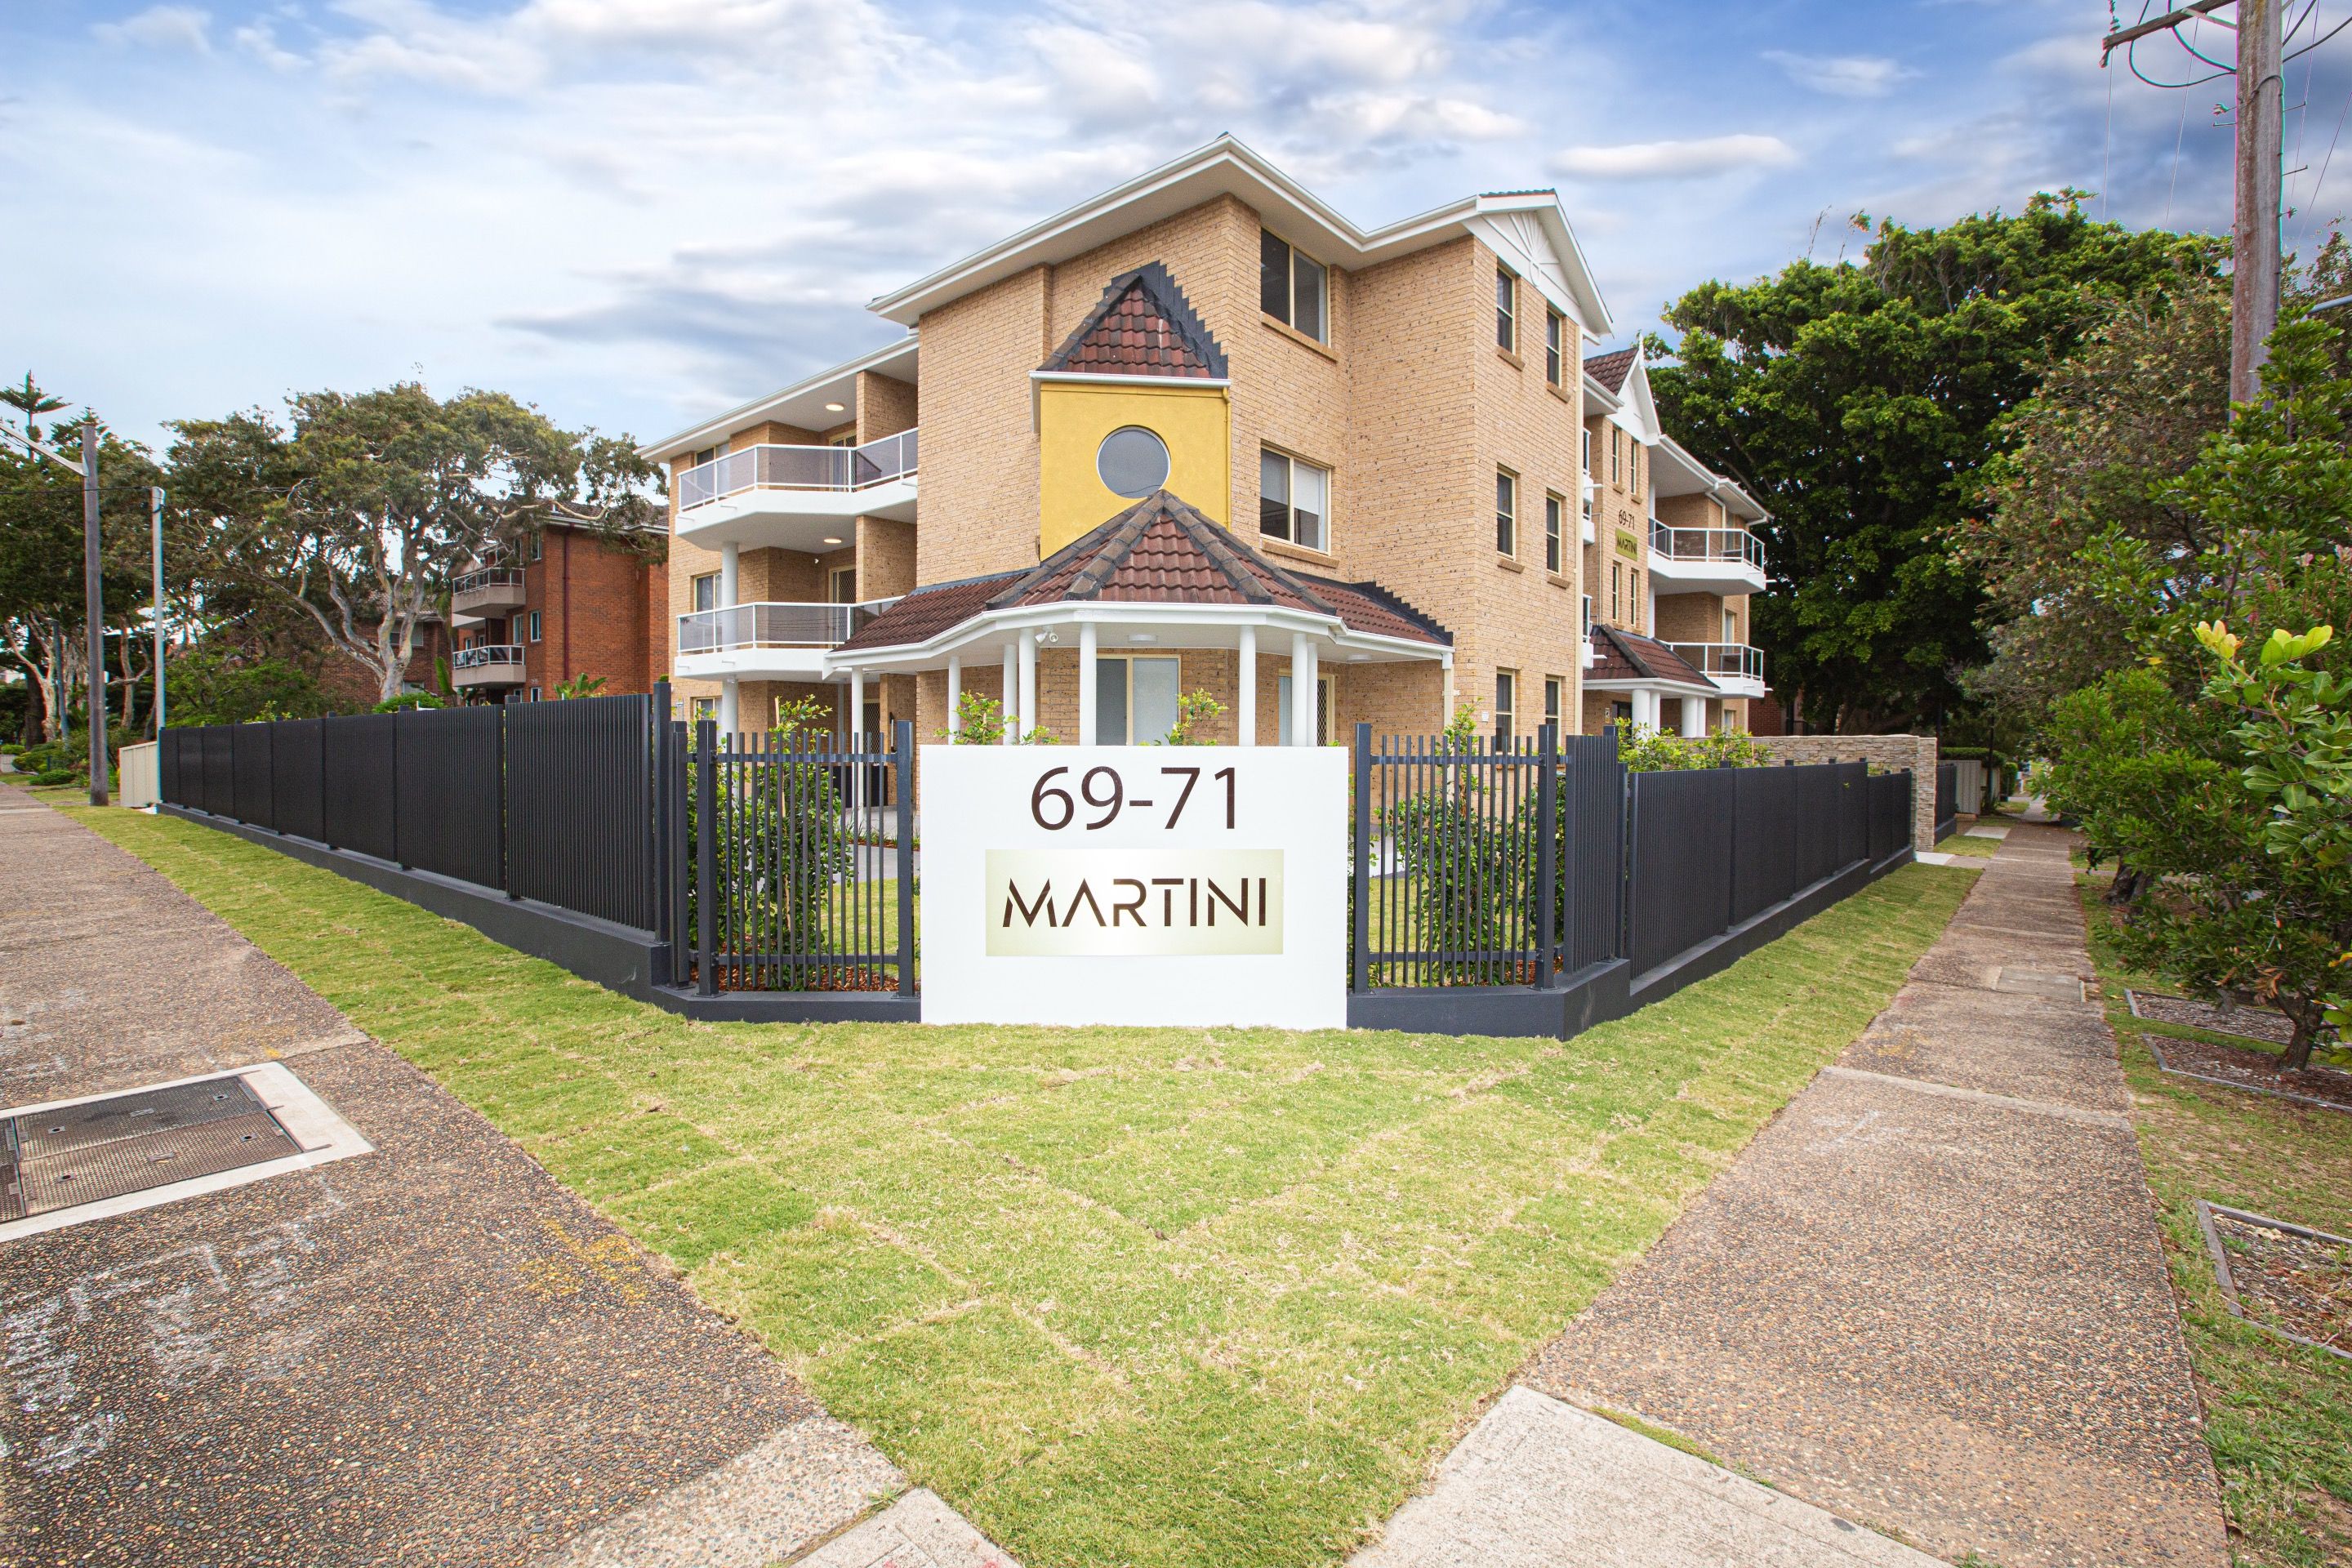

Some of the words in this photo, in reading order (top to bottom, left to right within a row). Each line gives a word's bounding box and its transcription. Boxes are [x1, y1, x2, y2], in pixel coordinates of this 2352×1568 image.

[1619, 510, 1634, 530] 69-71
[1617, 536, 1637, 555] MARTINI
[1031, 766, 1235, 831] 69-71
[1003, 877, 1266, 928] MARTINI
